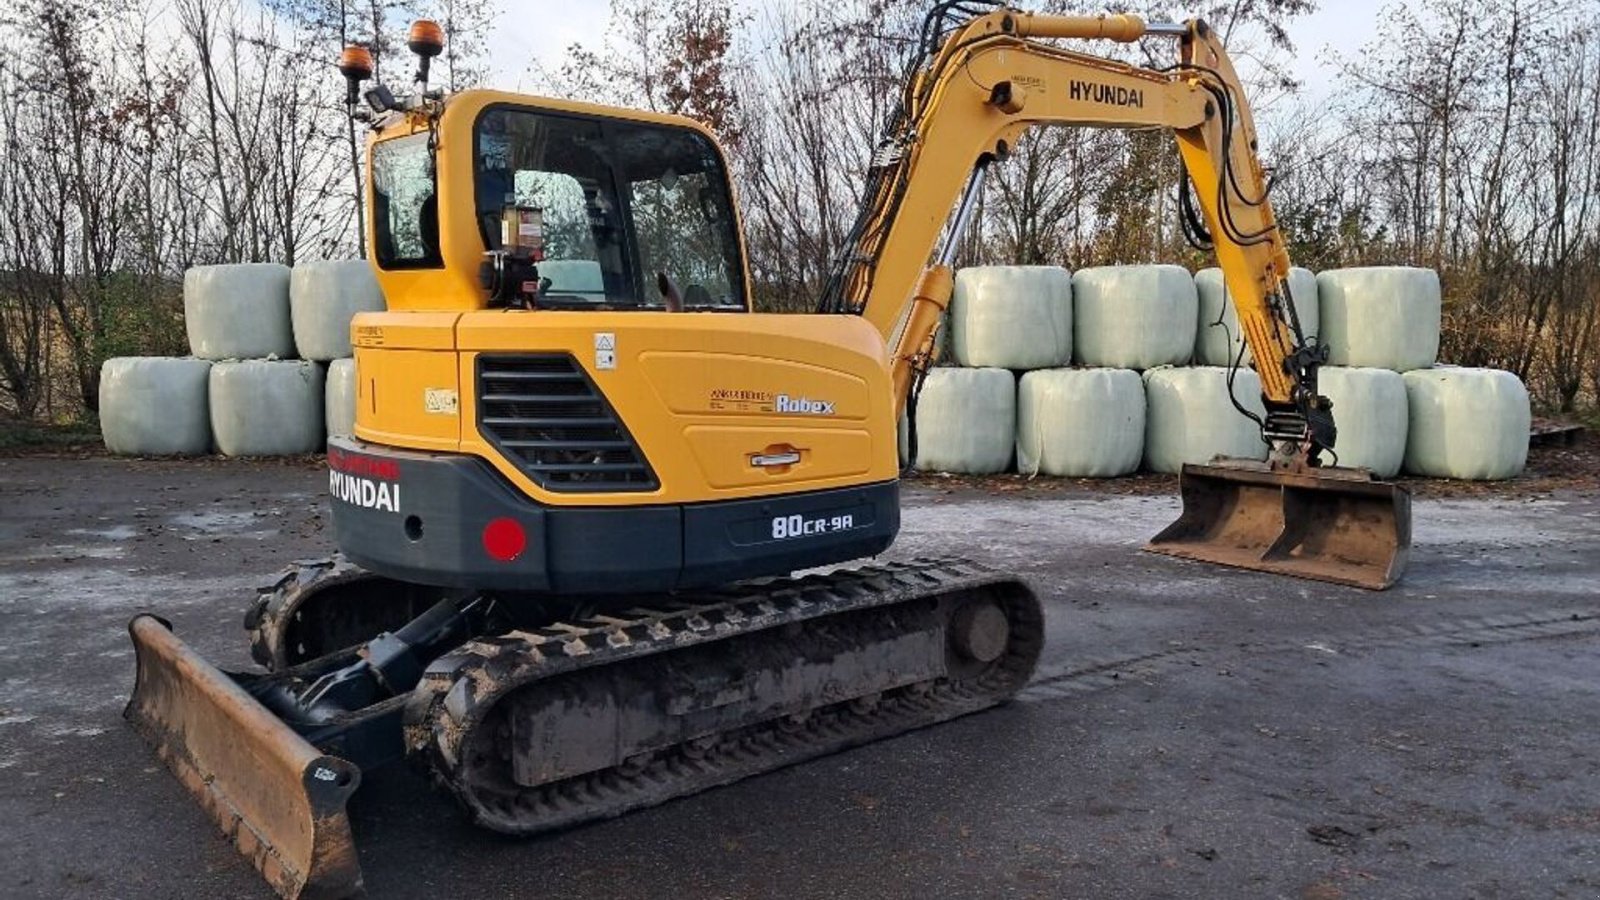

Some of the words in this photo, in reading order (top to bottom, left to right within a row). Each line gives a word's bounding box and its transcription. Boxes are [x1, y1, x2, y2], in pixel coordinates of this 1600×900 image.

[1070, 80, 1143, 108] HYUNDAI
[776, 394, 835, 414] Robex
[329, 468, 400, 512] HYUNDAI
